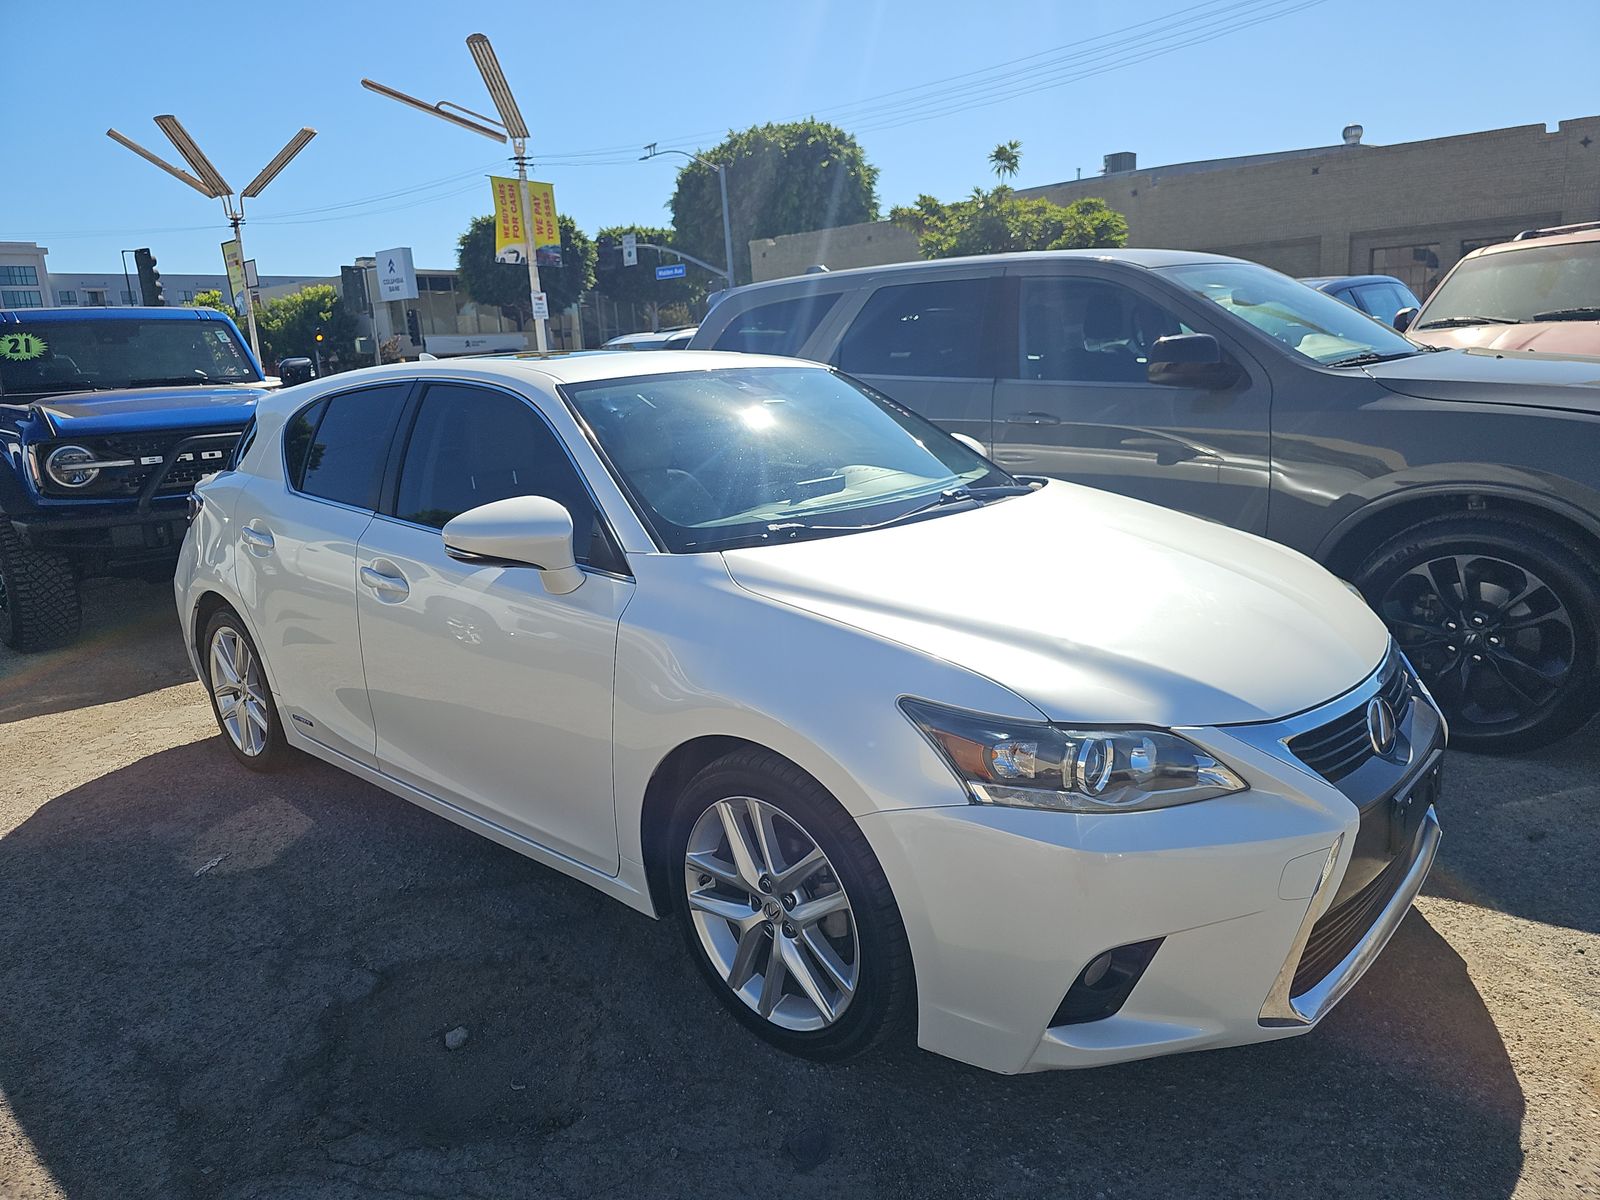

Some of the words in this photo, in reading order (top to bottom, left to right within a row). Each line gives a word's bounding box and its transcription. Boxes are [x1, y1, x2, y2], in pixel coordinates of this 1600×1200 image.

[499, 183, 507, 205] CARS
[508, 184, 517, 213] CASH
[532, 194, 542, 215] PAY
[503, 225, 510, 239] WE
[512, 216, 520, 239] FOR
[535, 217, 544, 235] WE
[546, 220, 554, 240] TOP
[8, 338, 30, 353] 21
